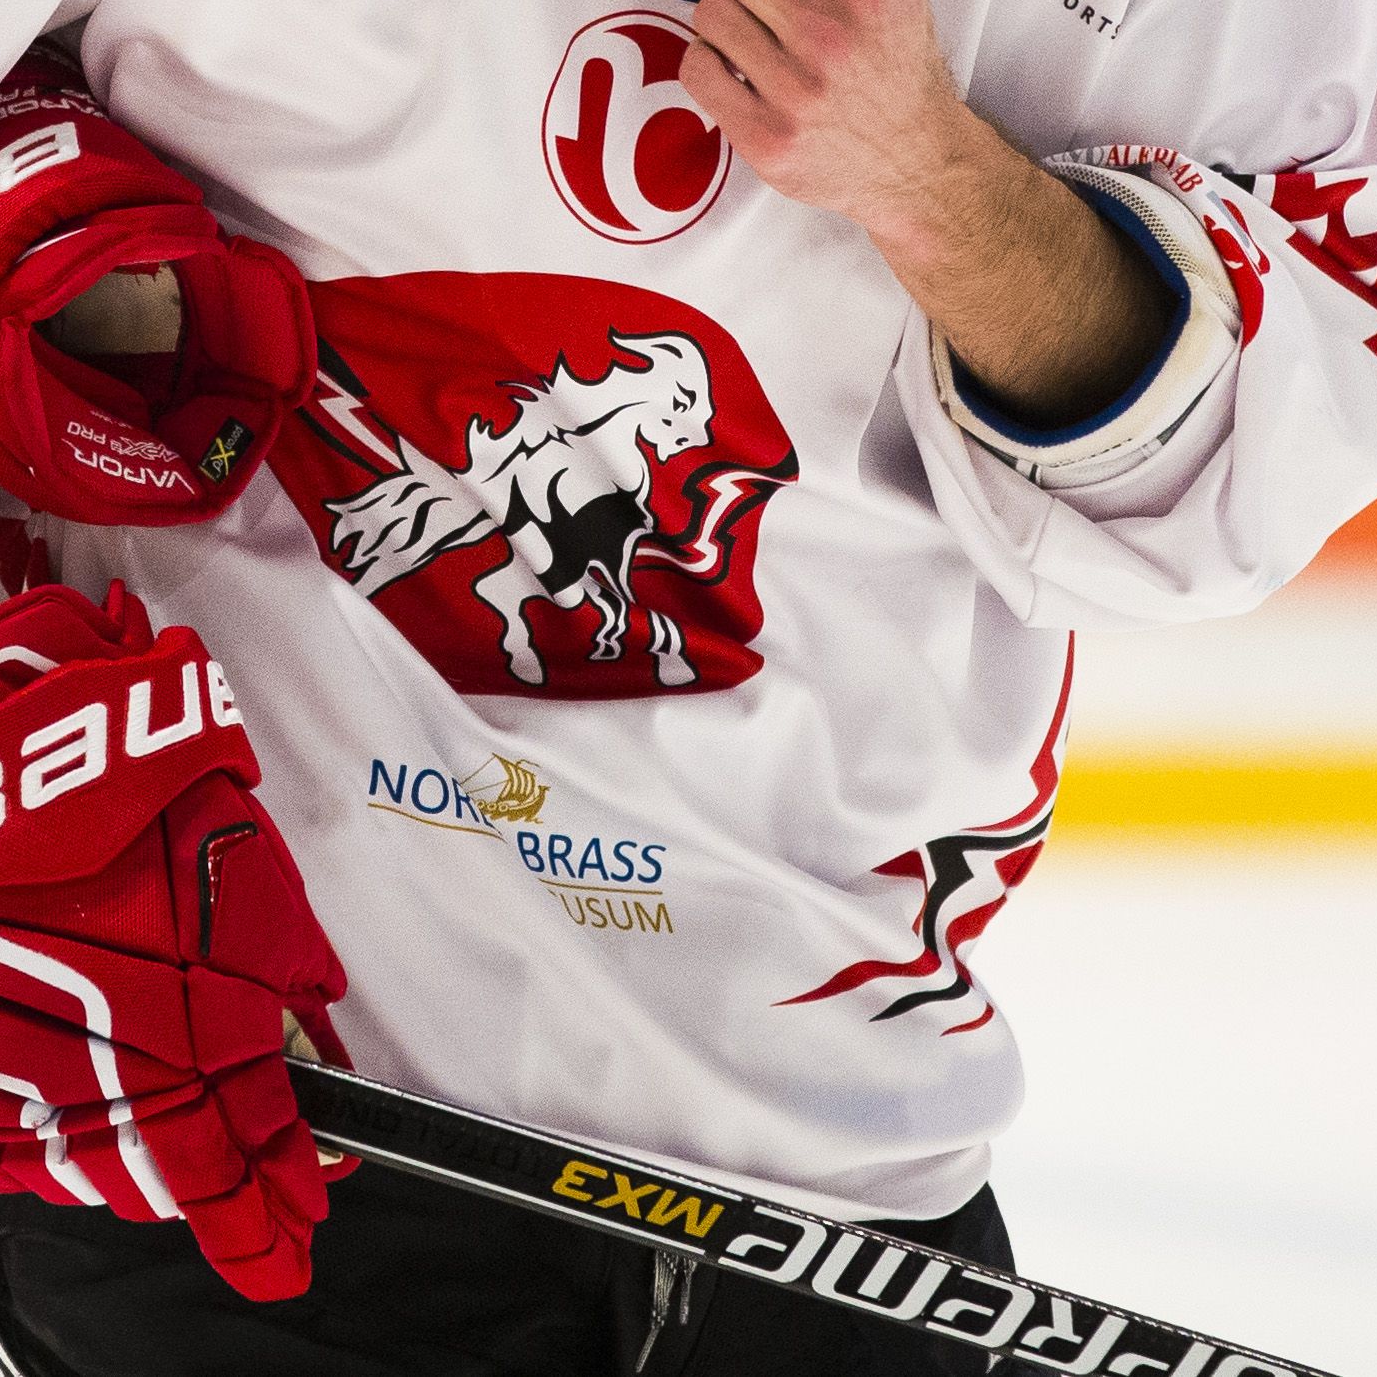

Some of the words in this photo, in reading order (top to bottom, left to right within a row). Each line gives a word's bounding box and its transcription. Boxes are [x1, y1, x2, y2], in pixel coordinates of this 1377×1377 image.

[67, 421, 106, 445] PRO
[517, 831, 666, 884] BRASS
[552, 890, 674, 934] USUM
[551, 1160, 725, 1239] MX3
